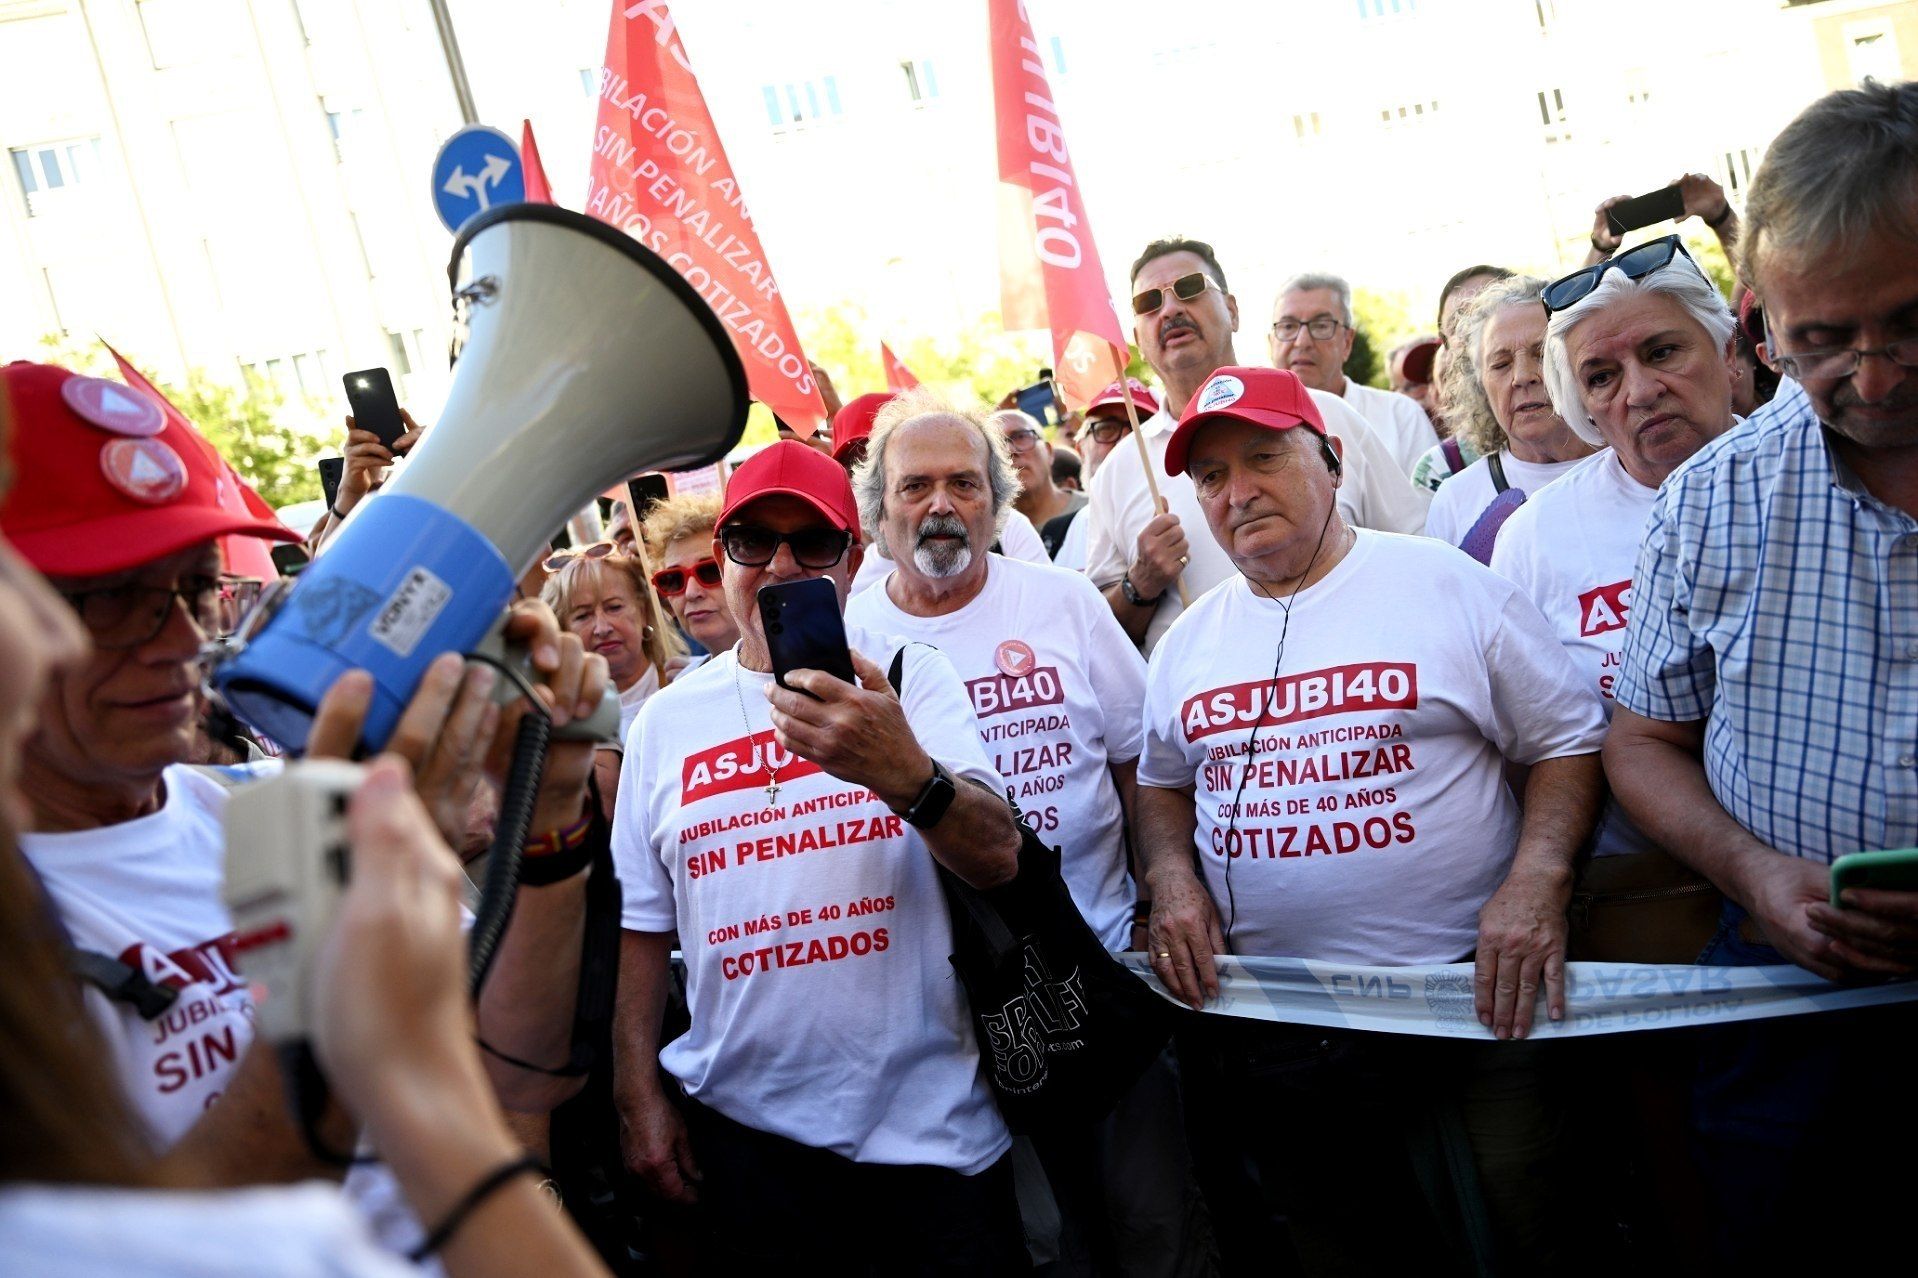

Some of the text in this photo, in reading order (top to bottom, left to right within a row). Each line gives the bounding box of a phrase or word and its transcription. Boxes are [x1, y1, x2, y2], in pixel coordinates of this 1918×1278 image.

[594, 125, 779, 302] SIN PENALIZAR
[590, 191, 816, 395] AÑOS COTIZADOS
[973, 671, 1057, 715] BI40
[1186, 668, 1410, 735] ASJUBI40
[980, 714, 1071, 743] NTICIPADA
[1207, 723, 1403, 762] UBILACIÓN ANTICIPADA
[686, 740, 809, 792] ASJU
[995, 742, 1072, 778] LIZAR
[1204, 743, 1415, 793] SIN PENALIZAR
[1020, 774, 1065, 798] AÑOS
[1217, 787, 1397, 819] CON MÁS DE 40 AÑOS
[679, 789, 880, 845] JUBILACIÓN ANTICIPA
[1024, 805, 1059, 834] OS
[1212, 811, 1415, 859] COTIZADOS
[687, 814, 904, 880] SIN PENALIZAR
[708, 895, 896, 946] CON MÁS DE 40 AÑOS
[722, 927, 890, 981] COTIZADOS
[153, 1025, 238, 1094] SIN
